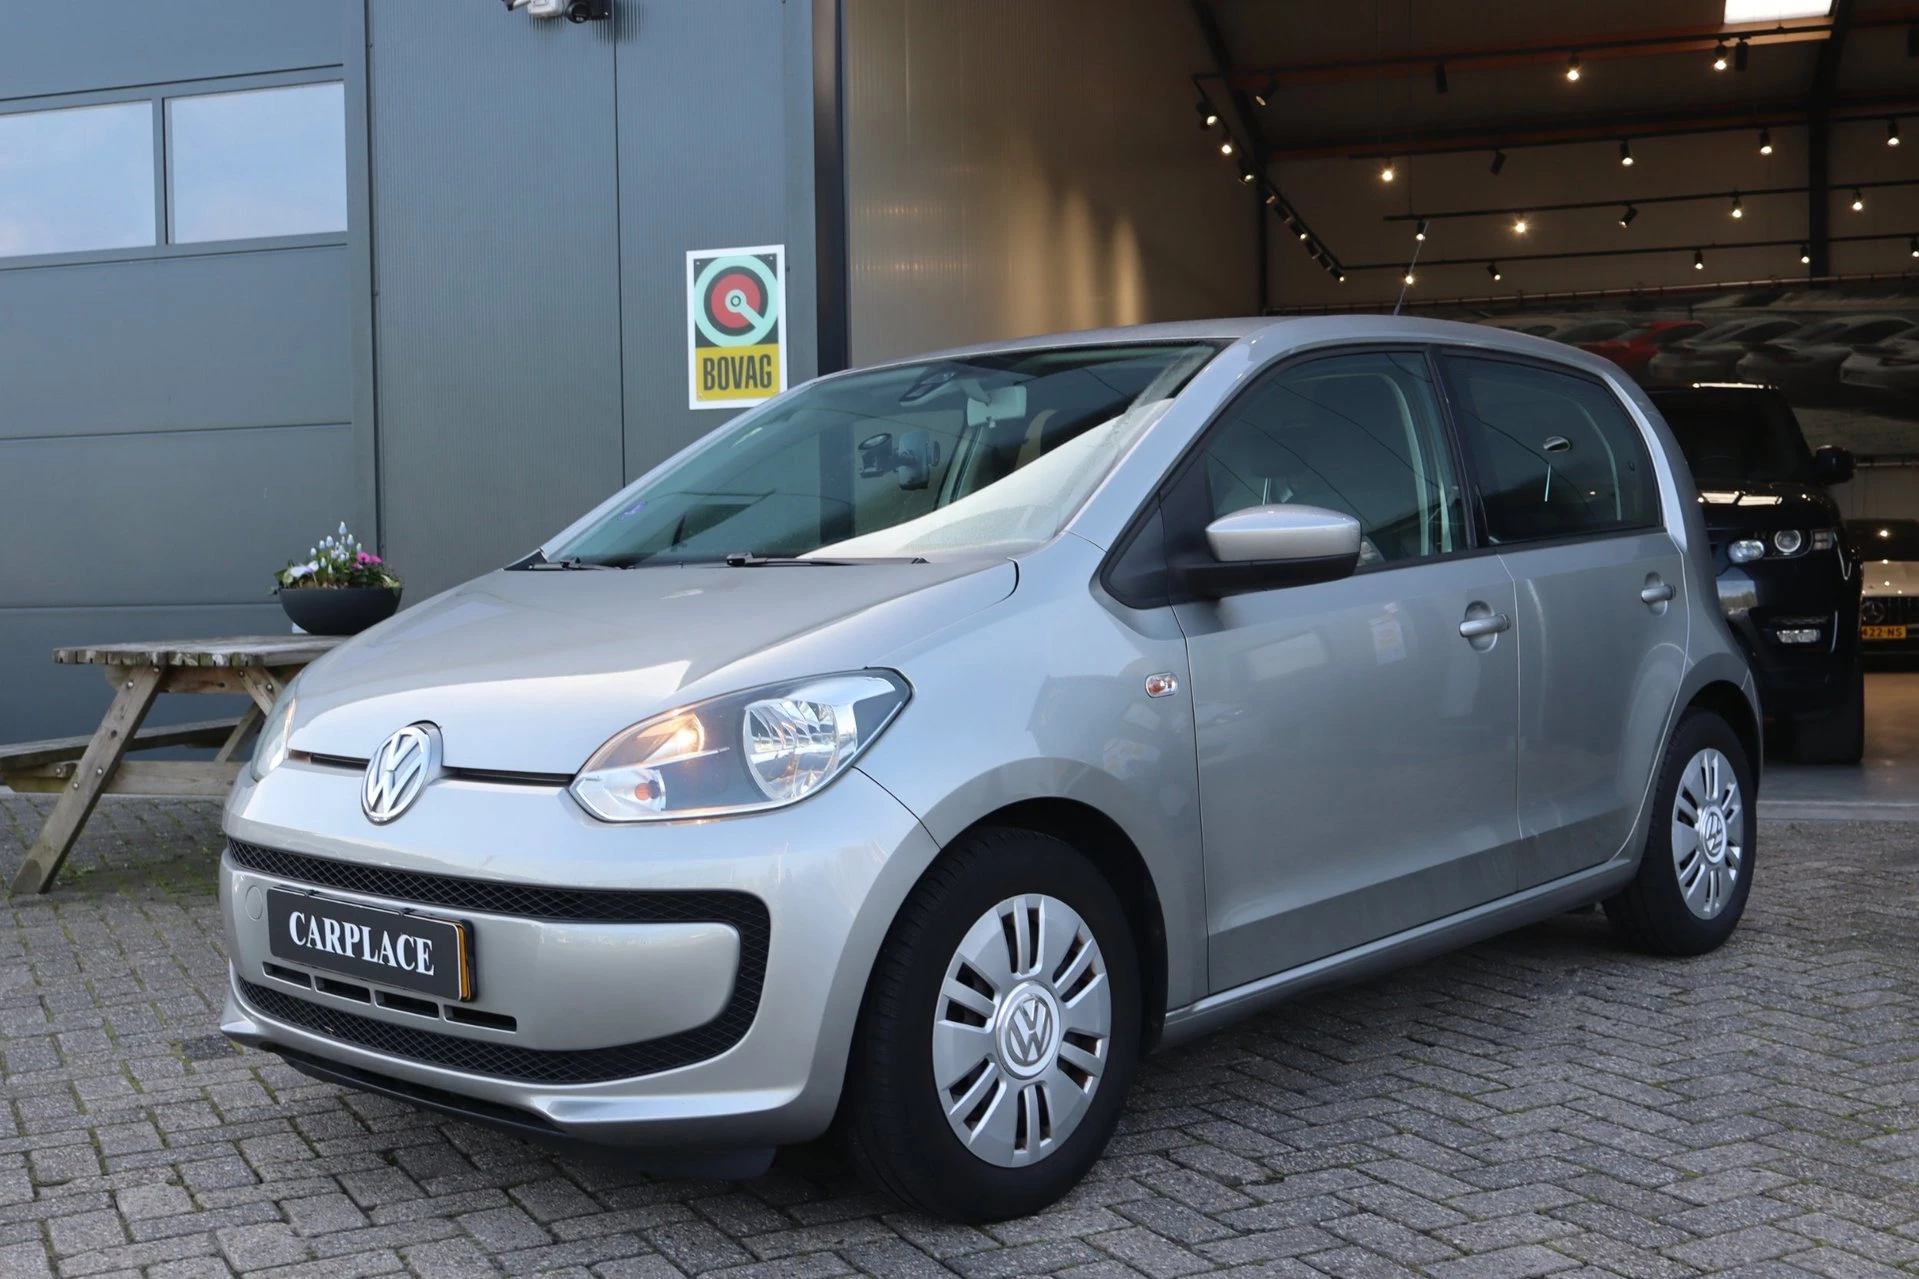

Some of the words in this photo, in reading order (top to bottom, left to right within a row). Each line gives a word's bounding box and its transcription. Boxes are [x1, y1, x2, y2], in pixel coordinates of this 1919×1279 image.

[703, 354, 772, 391] BOVAG
[363, 728, 430, 820] VW
[289, 911, 434, 976] CARPLACE
[1005, 994, 1052, 1066] VW
